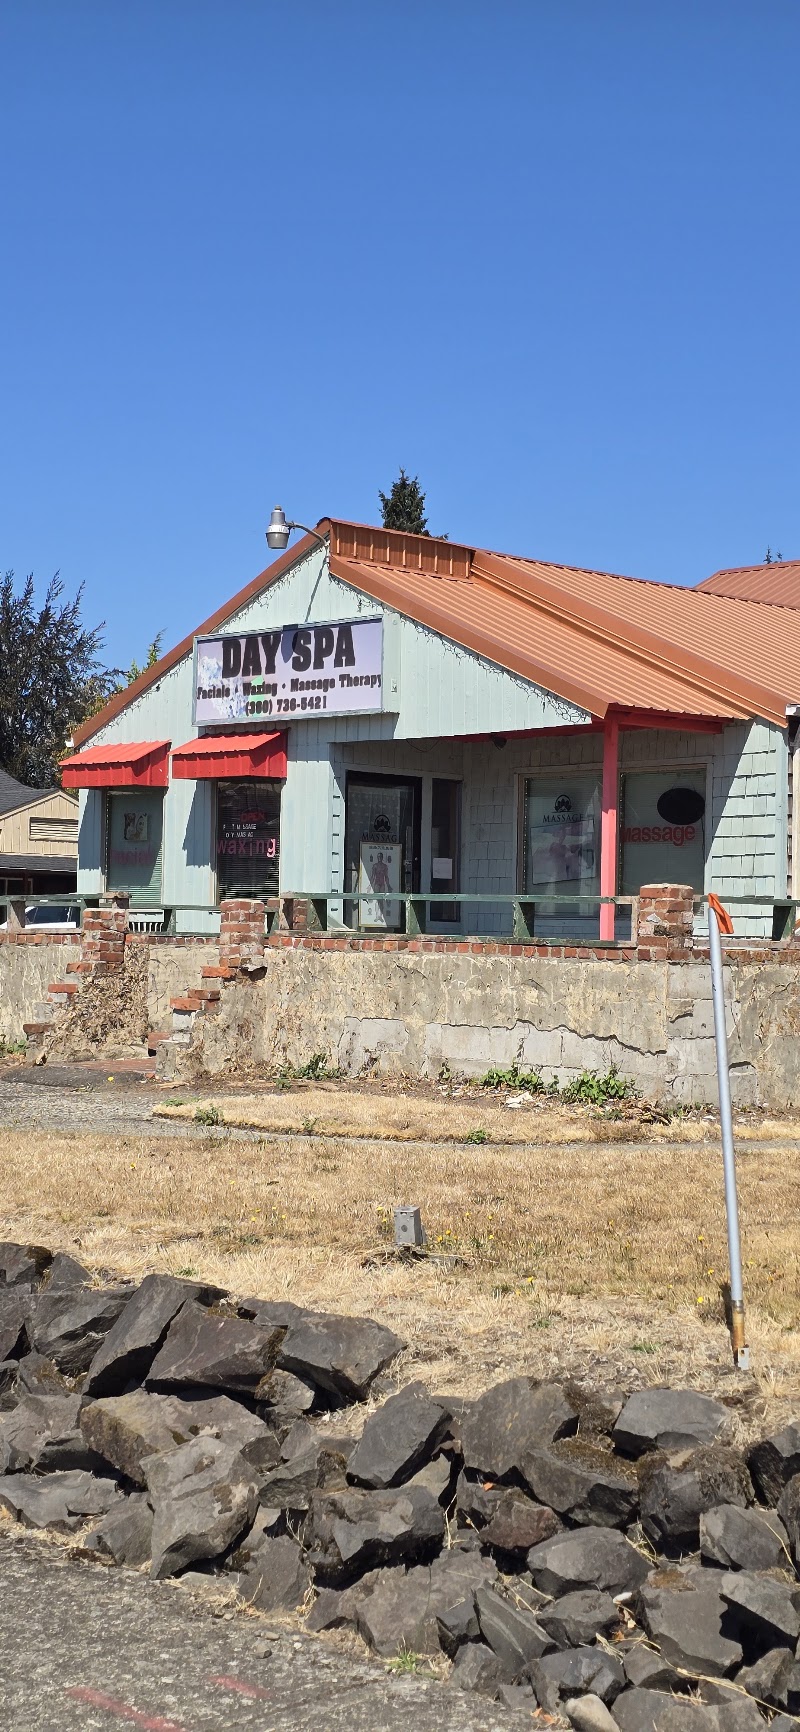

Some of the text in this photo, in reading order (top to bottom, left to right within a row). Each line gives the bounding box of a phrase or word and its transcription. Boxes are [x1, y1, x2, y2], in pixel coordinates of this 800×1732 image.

[222, 626, 355, 678] DAY SPA
[197, 674, 381, 700] Facials Waxing Massage Therapy
[542, 814, 583, 823] MASSAGE
[217, 838, 276, 858] waxing
